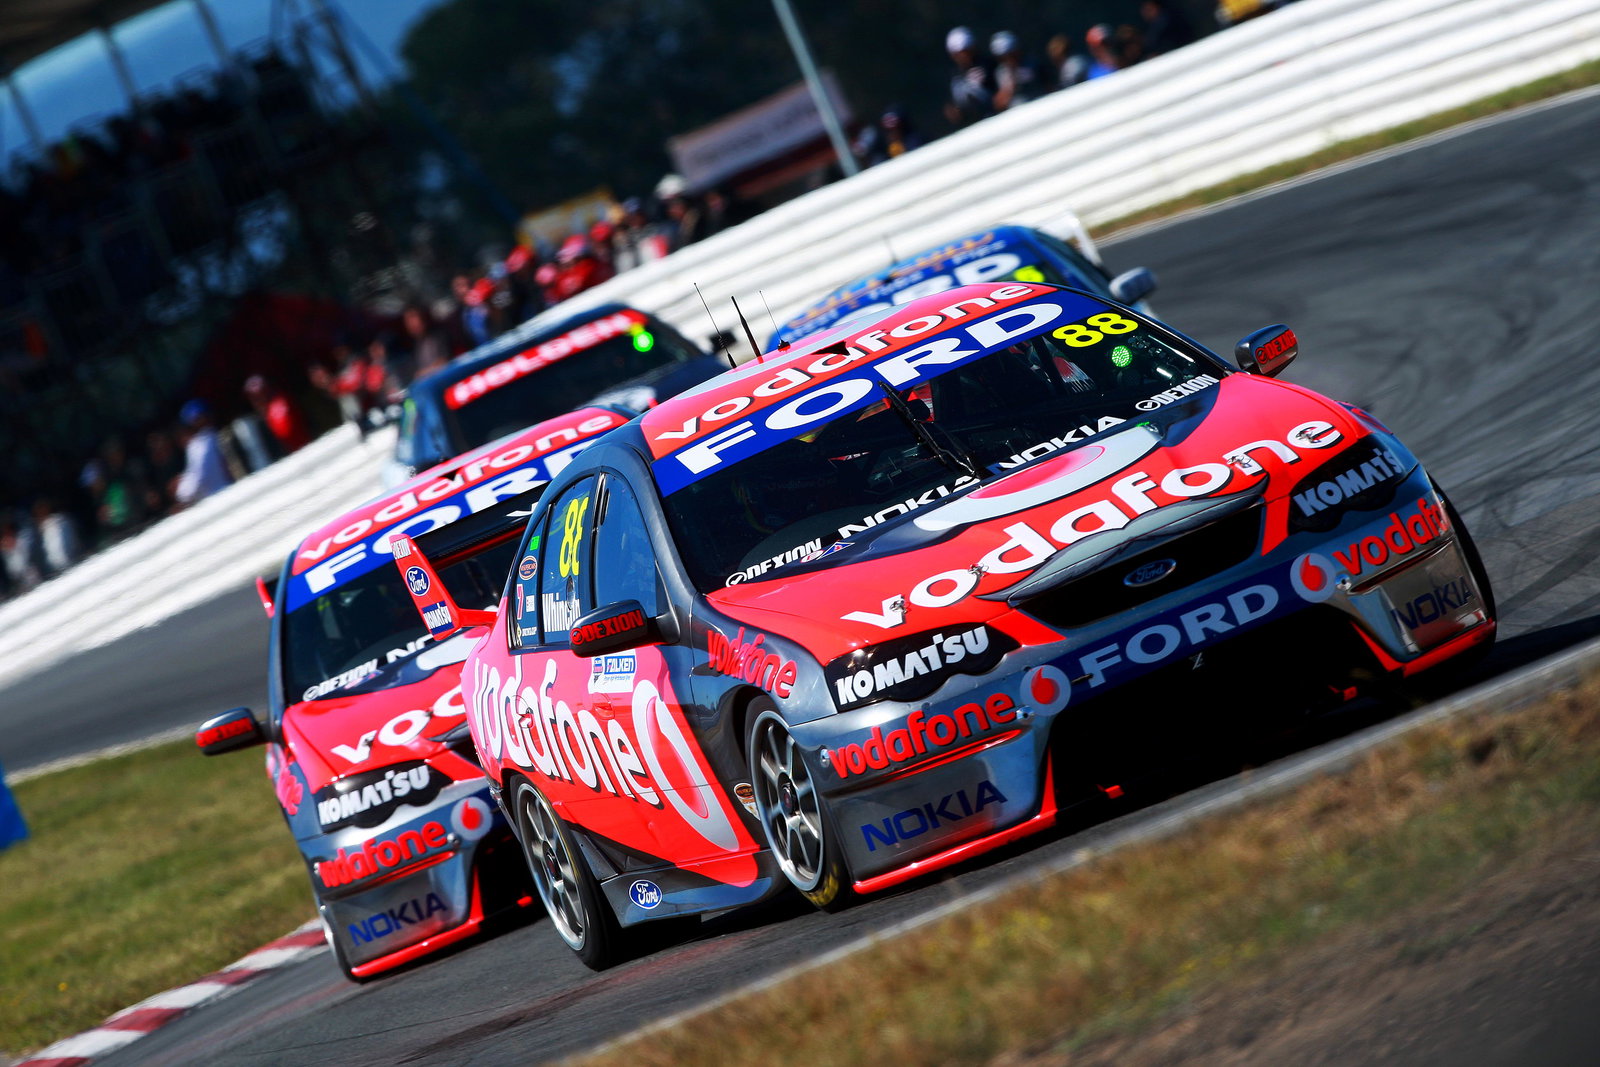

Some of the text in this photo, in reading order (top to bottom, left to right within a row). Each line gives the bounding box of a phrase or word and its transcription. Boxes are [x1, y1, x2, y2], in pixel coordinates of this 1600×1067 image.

[654, 284, 1033, 442] vodafone
[1052, 312, 1139, 347] 88
[675, 303, 1063, 475] FORD
[1154, 374, 1219, 405] DEXION
[999, 415, 1127, 472] NOKIA
[301, 415, 613, 561] vodafone
[838, 475, 981, 539] NOKIA
[841, 420, 1341, 628] vodafone
[582, 609, 644, 642] DEXION
[1078, 583, 1279, 689] FORD
[606, 657, 634, 673] FALKEN
[707, 626, 797, 699] vodafone
[836, 626, 989, 705] KOMATSU
[472, 655, 661, 807] vodafone
[829, 692, 1018, 779] vodafone
[317, 764, 430, 827] KOMATSU
[861, 780, 1007, 852] NOKIA
[318, 820, 448, 889] vodafone
[348, 893, 448, 947] NOKIA
